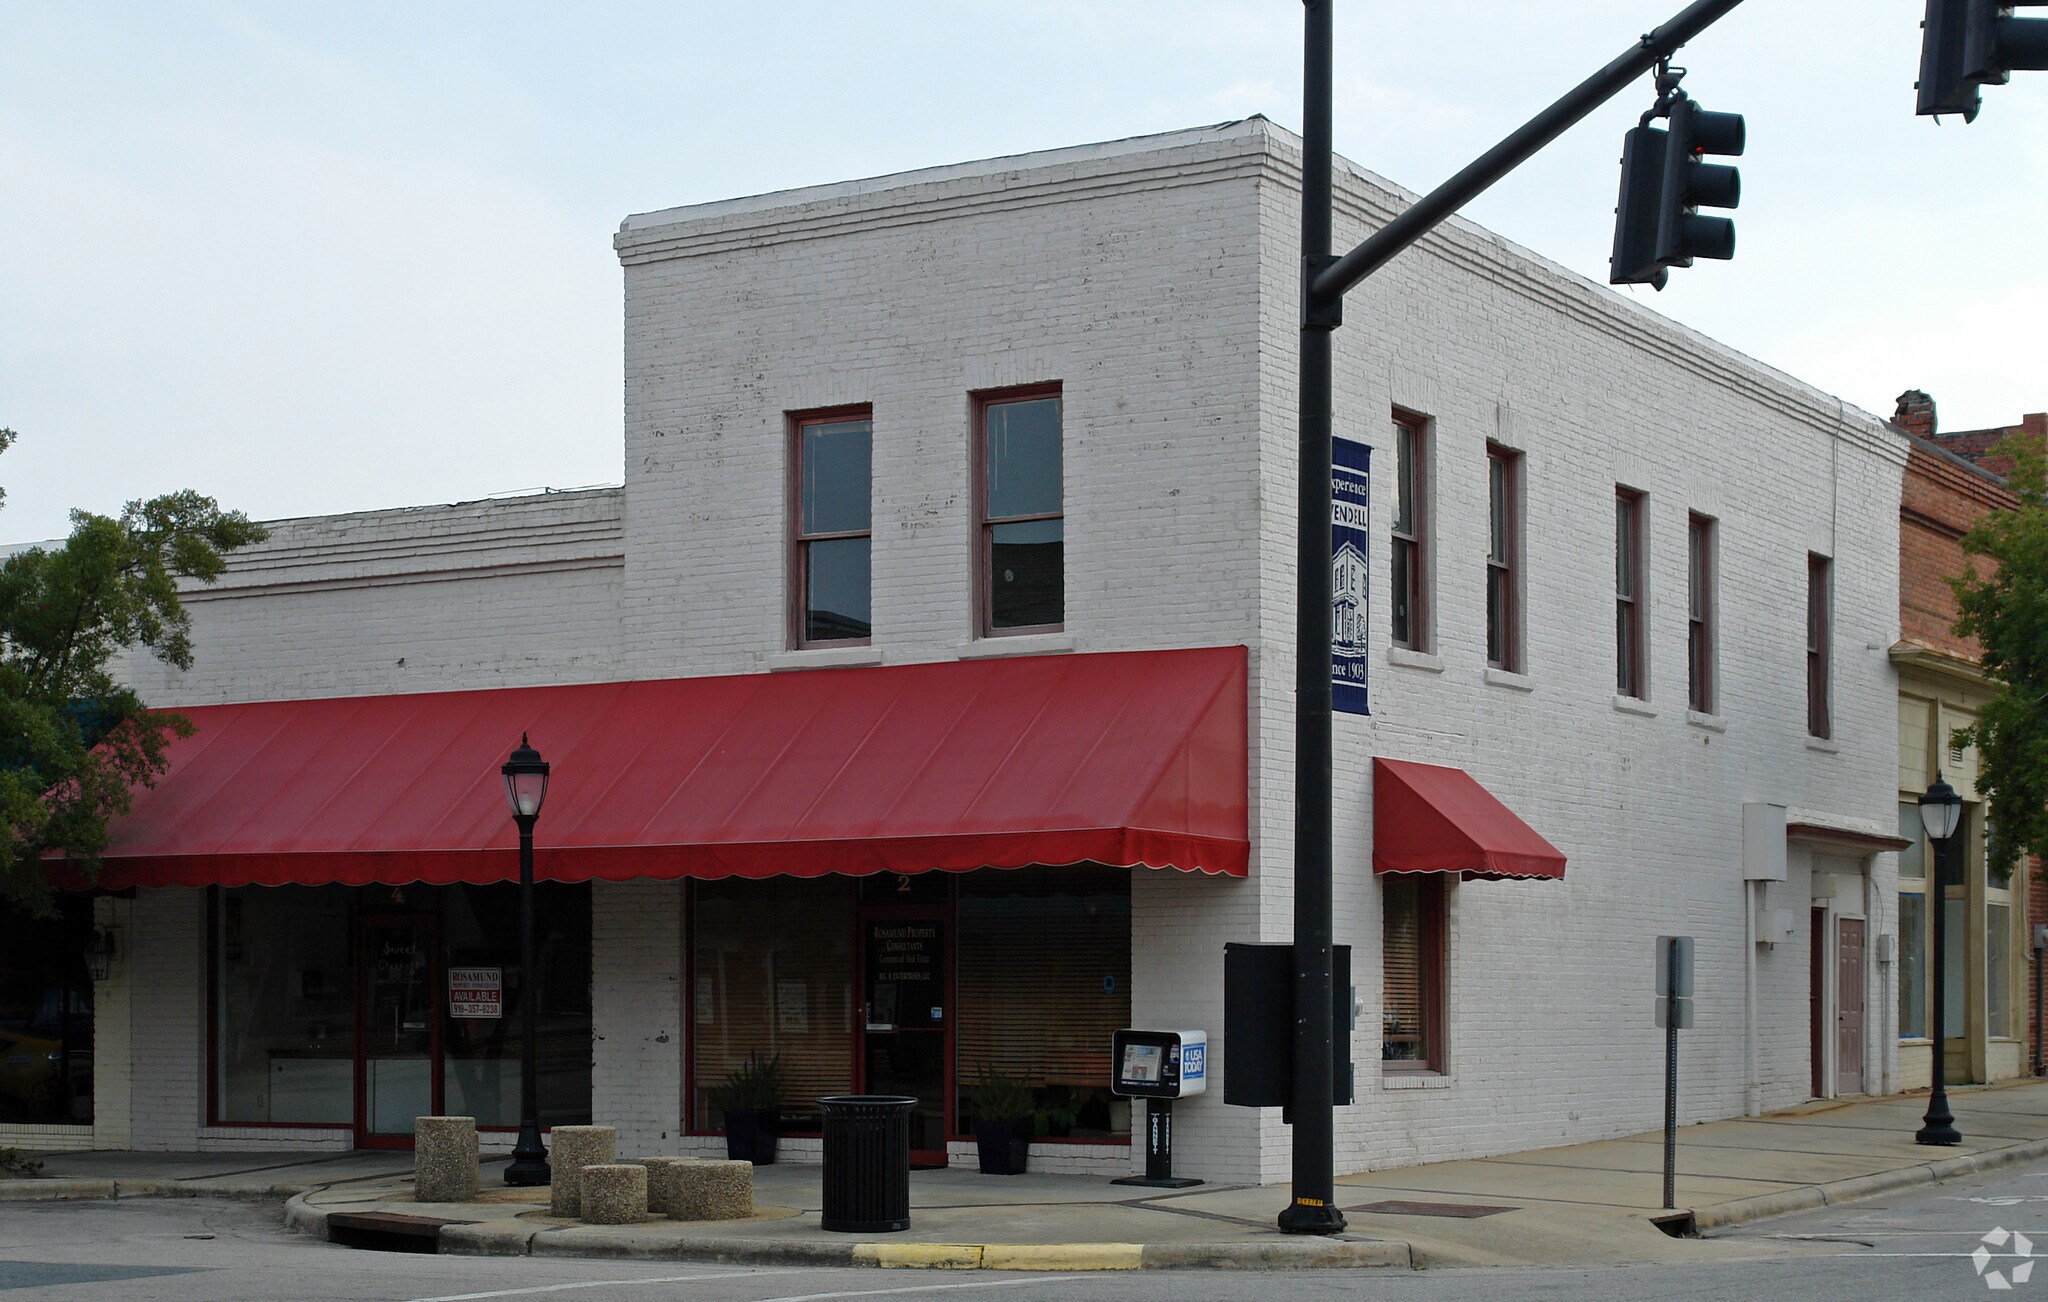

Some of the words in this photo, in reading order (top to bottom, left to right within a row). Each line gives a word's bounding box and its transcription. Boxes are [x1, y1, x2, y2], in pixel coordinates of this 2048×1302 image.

[1332, 477, 1366, 496] xperience
[1332, 664, 1346, 676] nce
[1348, 662, 1364, 680] 1903
[897, 875, 911, 891] 2
[452, 971, 499, 981] ROSAMUND
[454, 991, 497, 1002] AVAILABLE
[1190, 1048, 1203, 1061] USA
[1184, 1060, 1203, 1073] TODAY
